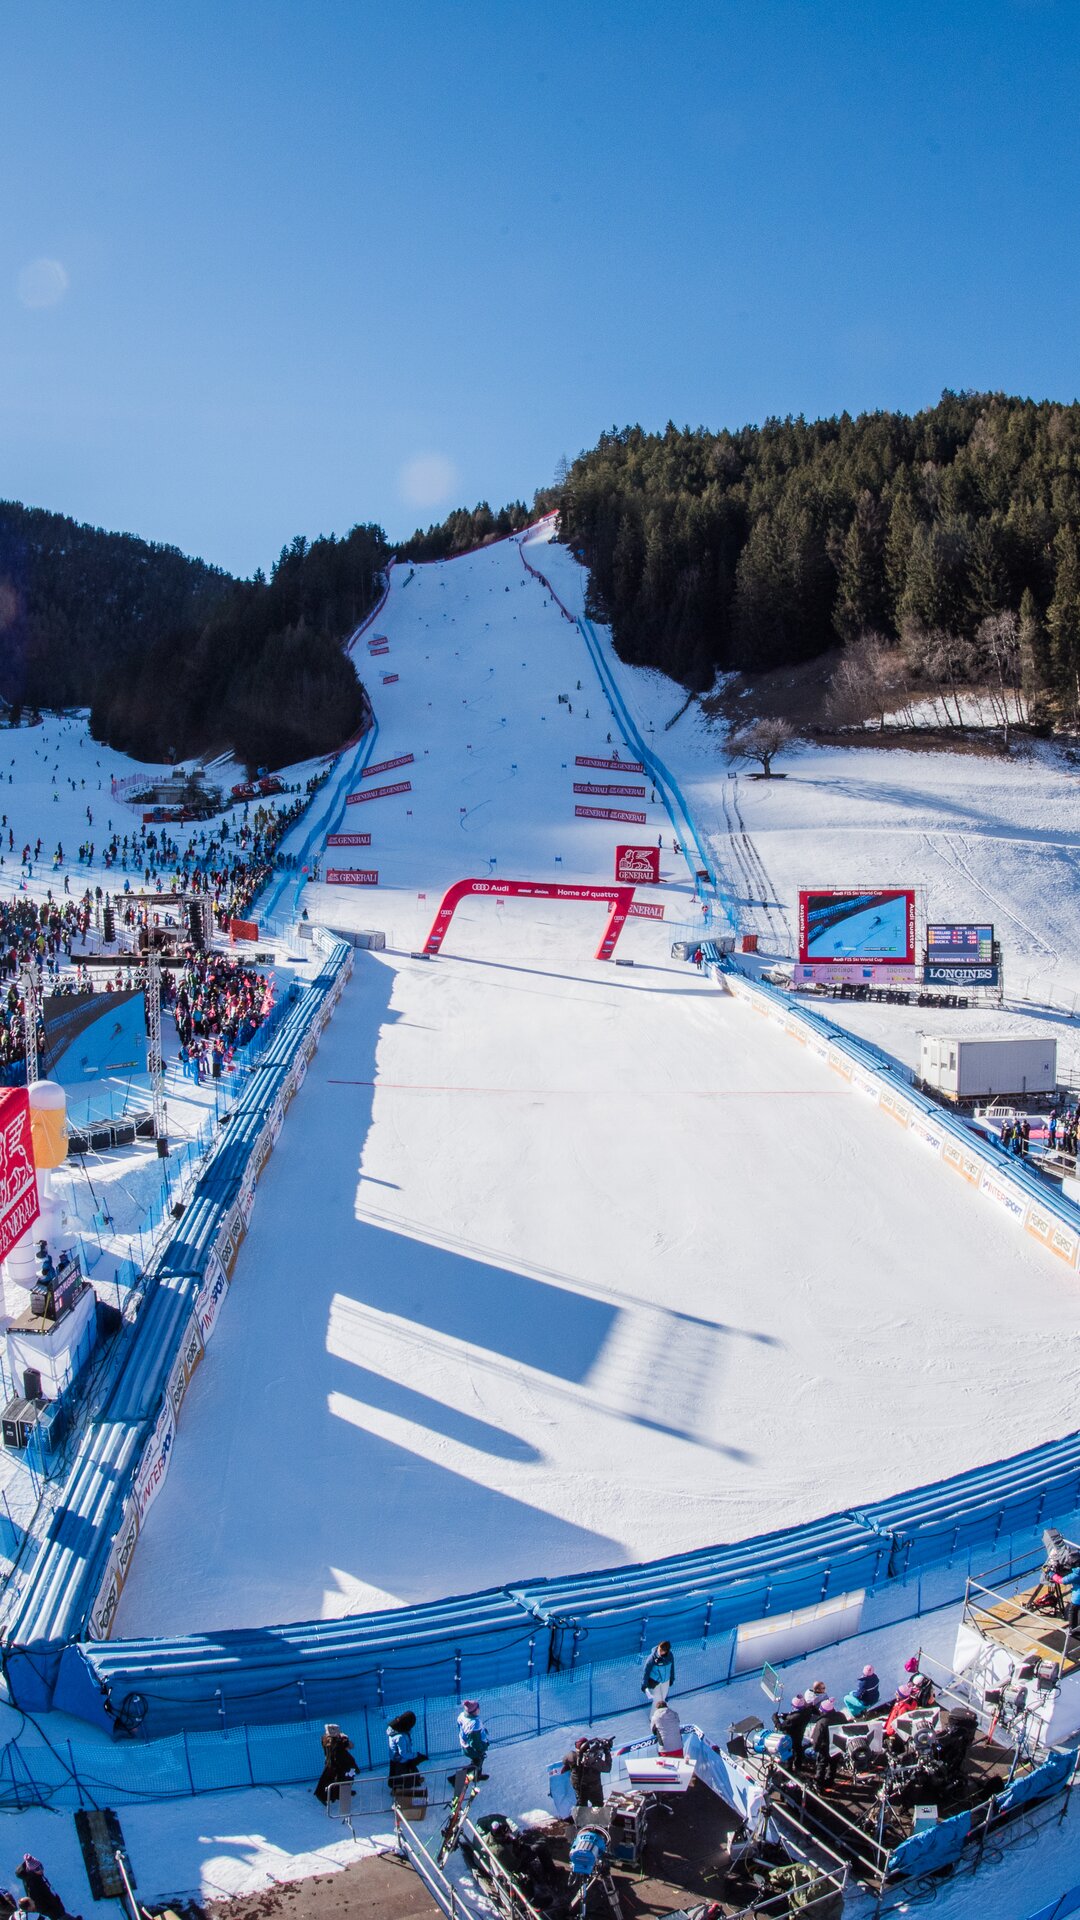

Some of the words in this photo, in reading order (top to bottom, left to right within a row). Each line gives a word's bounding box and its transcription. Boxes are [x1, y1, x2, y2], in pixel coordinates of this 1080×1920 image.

[616, 787, 645, 796] GENERALI
[617, 812, 646, 822] GENERALI
[338, 836, 370, 844] GENERALI
[339, 873, 378, 882] GENERALI
[619, 872, 654, 880] GENERALI
[929, 968, 992, 979] LONGINES
[987, 1183, 1023, 1218] INTERSPORT
[630, 1739, 656, 1752] SPORT
